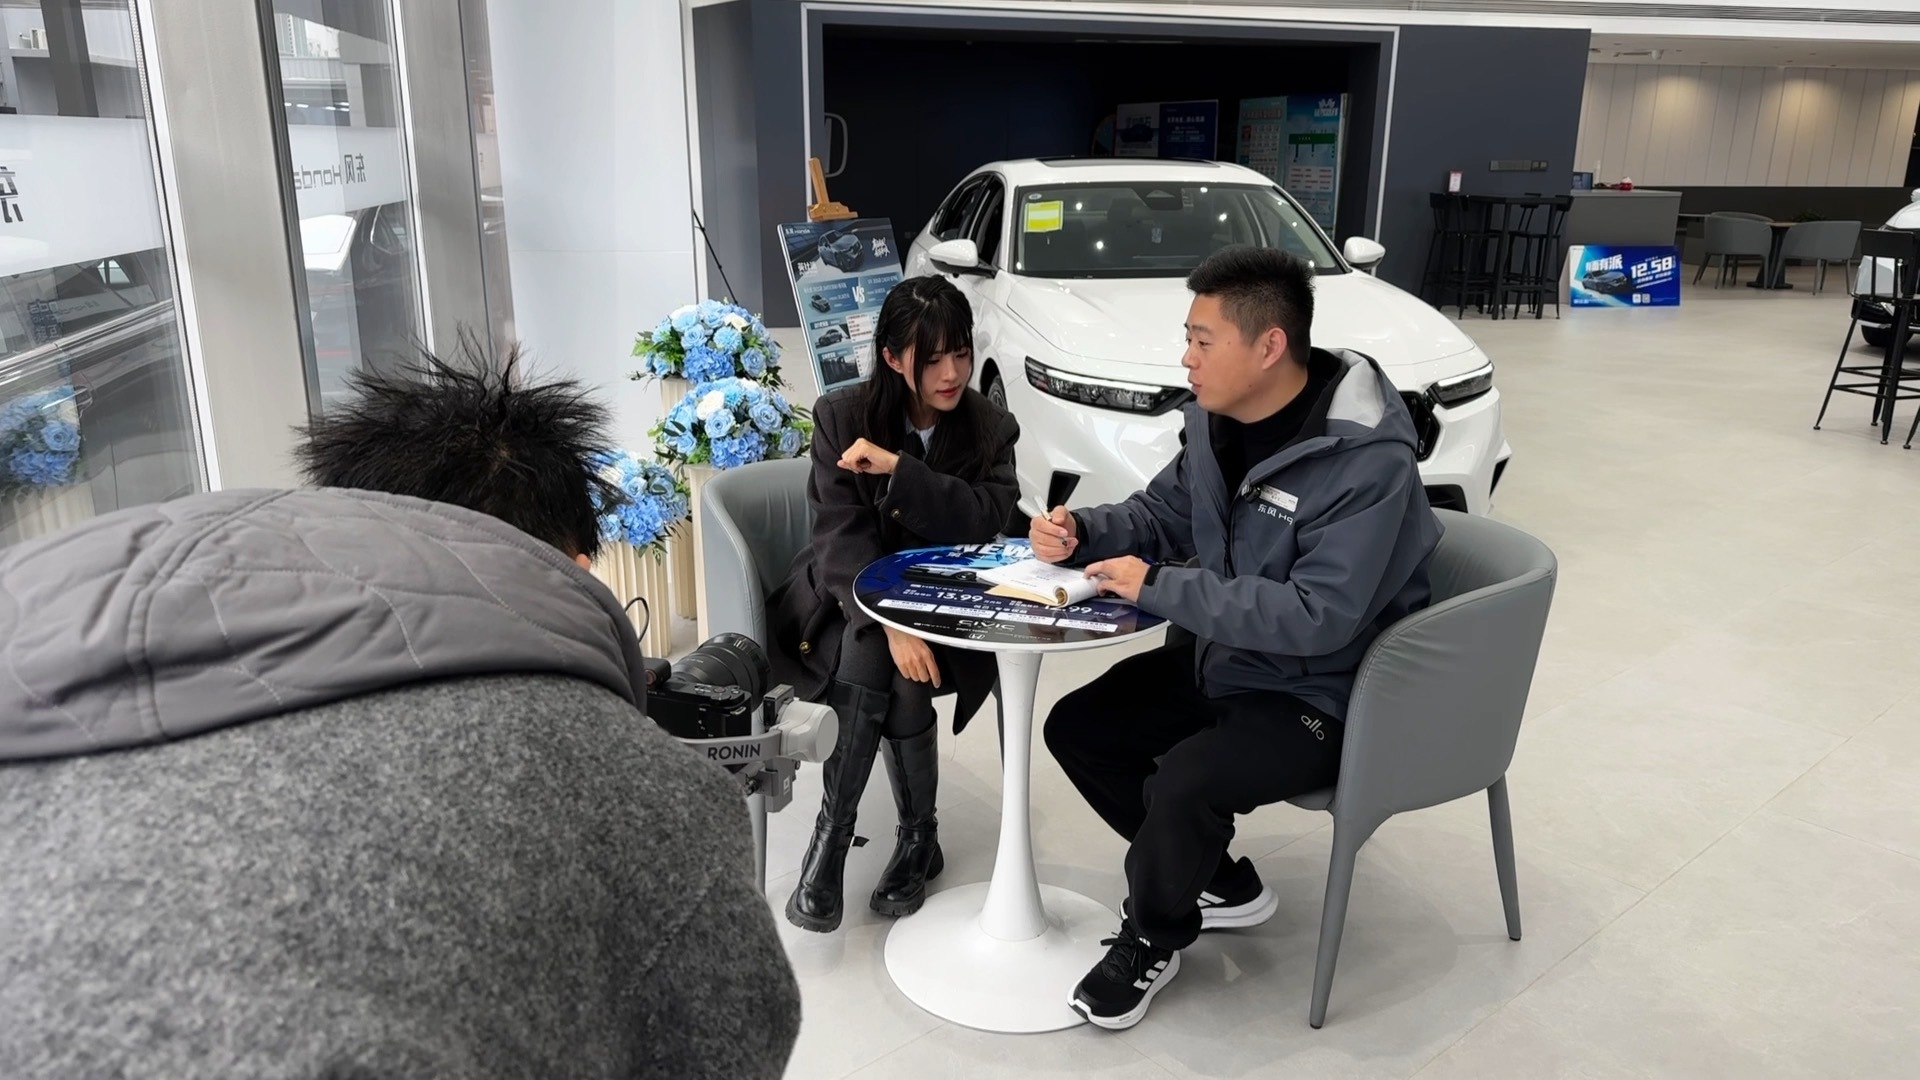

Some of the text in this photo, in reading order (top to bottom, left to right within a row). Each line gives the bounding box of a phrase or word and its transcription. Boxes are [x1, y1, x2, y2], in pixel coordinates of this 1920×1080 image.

[1631, 256, 1673, 279] 12.58
[852, 285, 866, 304] VS
[1257, 503, 1277, 518] 东风
[953, 543, 1035, 558] NEW
[936, 591, 984, 603] 13.99
[958, 619, 1016, 631] CIVIC
[707, 743, 761, 761] RONIN
